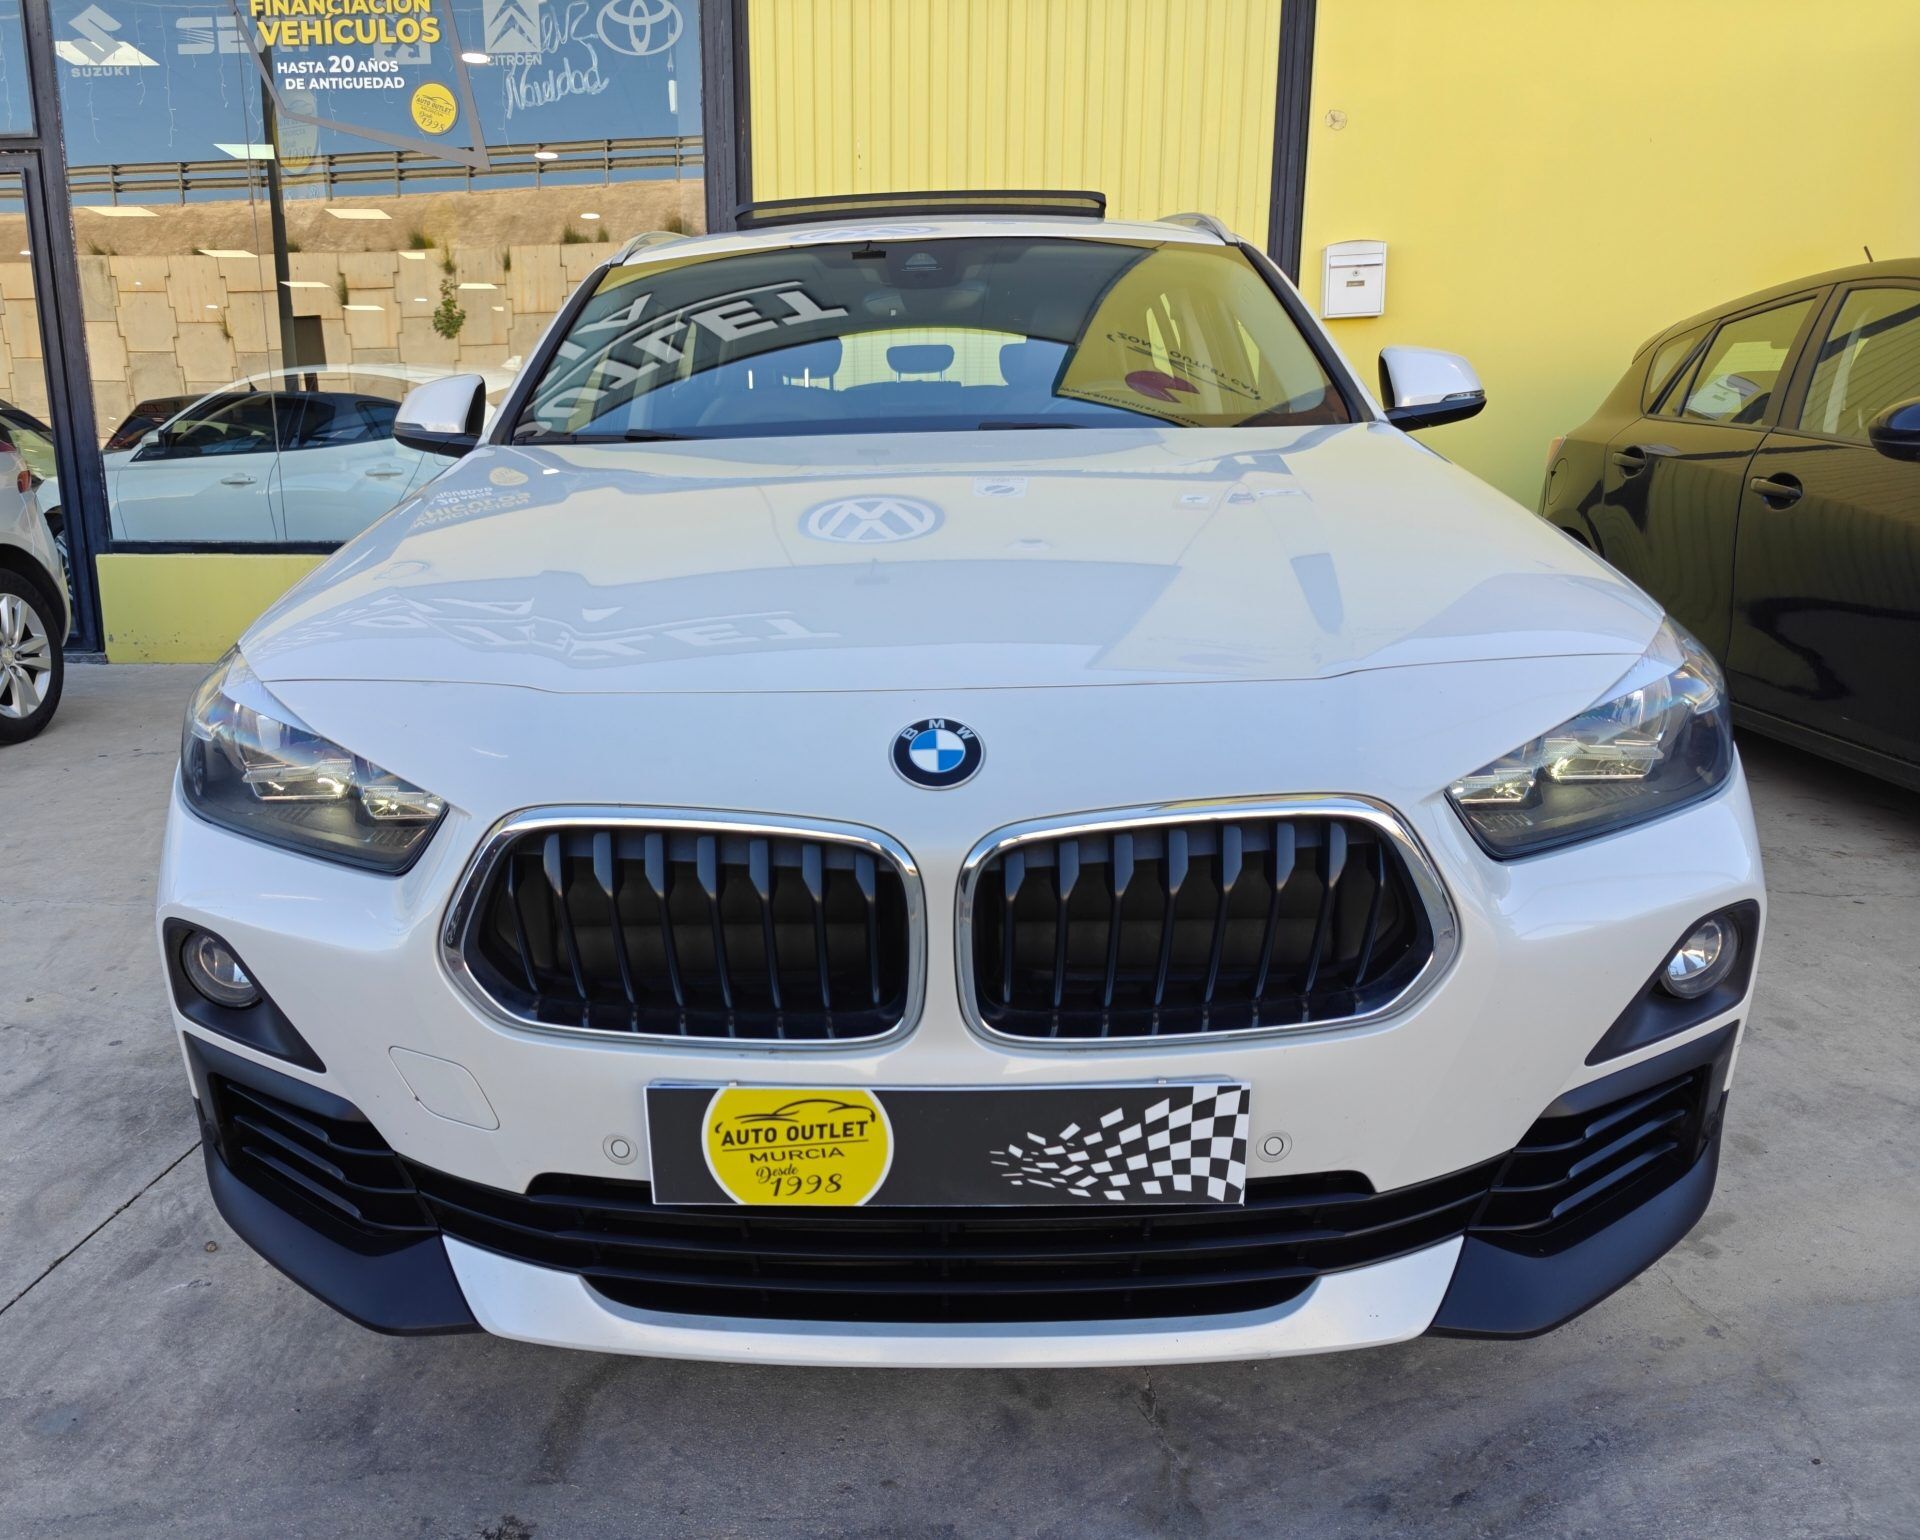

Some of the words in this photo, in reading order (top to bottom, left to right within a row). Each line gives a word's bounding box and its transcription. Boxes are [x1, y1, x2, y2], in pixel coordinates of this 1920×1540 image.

[257, 13, 441, 46] VEHÍCULOS
[71, 66, 130, 78] SUZUKI
[277, 62, 326, 74] HASTA
[328, 55, 355, 73] 20
[357, 57, 399, 73] AÑOS
[285, 78, 306, 90] DE
[309, 77, 405, 90] ANTIGUEDAD
[900, 719, 975, 741] BMW
[721, 1127, 777, 1147] AUTO
[786, 1120, 869, 1140] OUTLET
[750, 1147, 845, 1163] MURCIA
[756, 1163, 798, 1184] Desde
[770, 1173, 842, 1197] 1998
